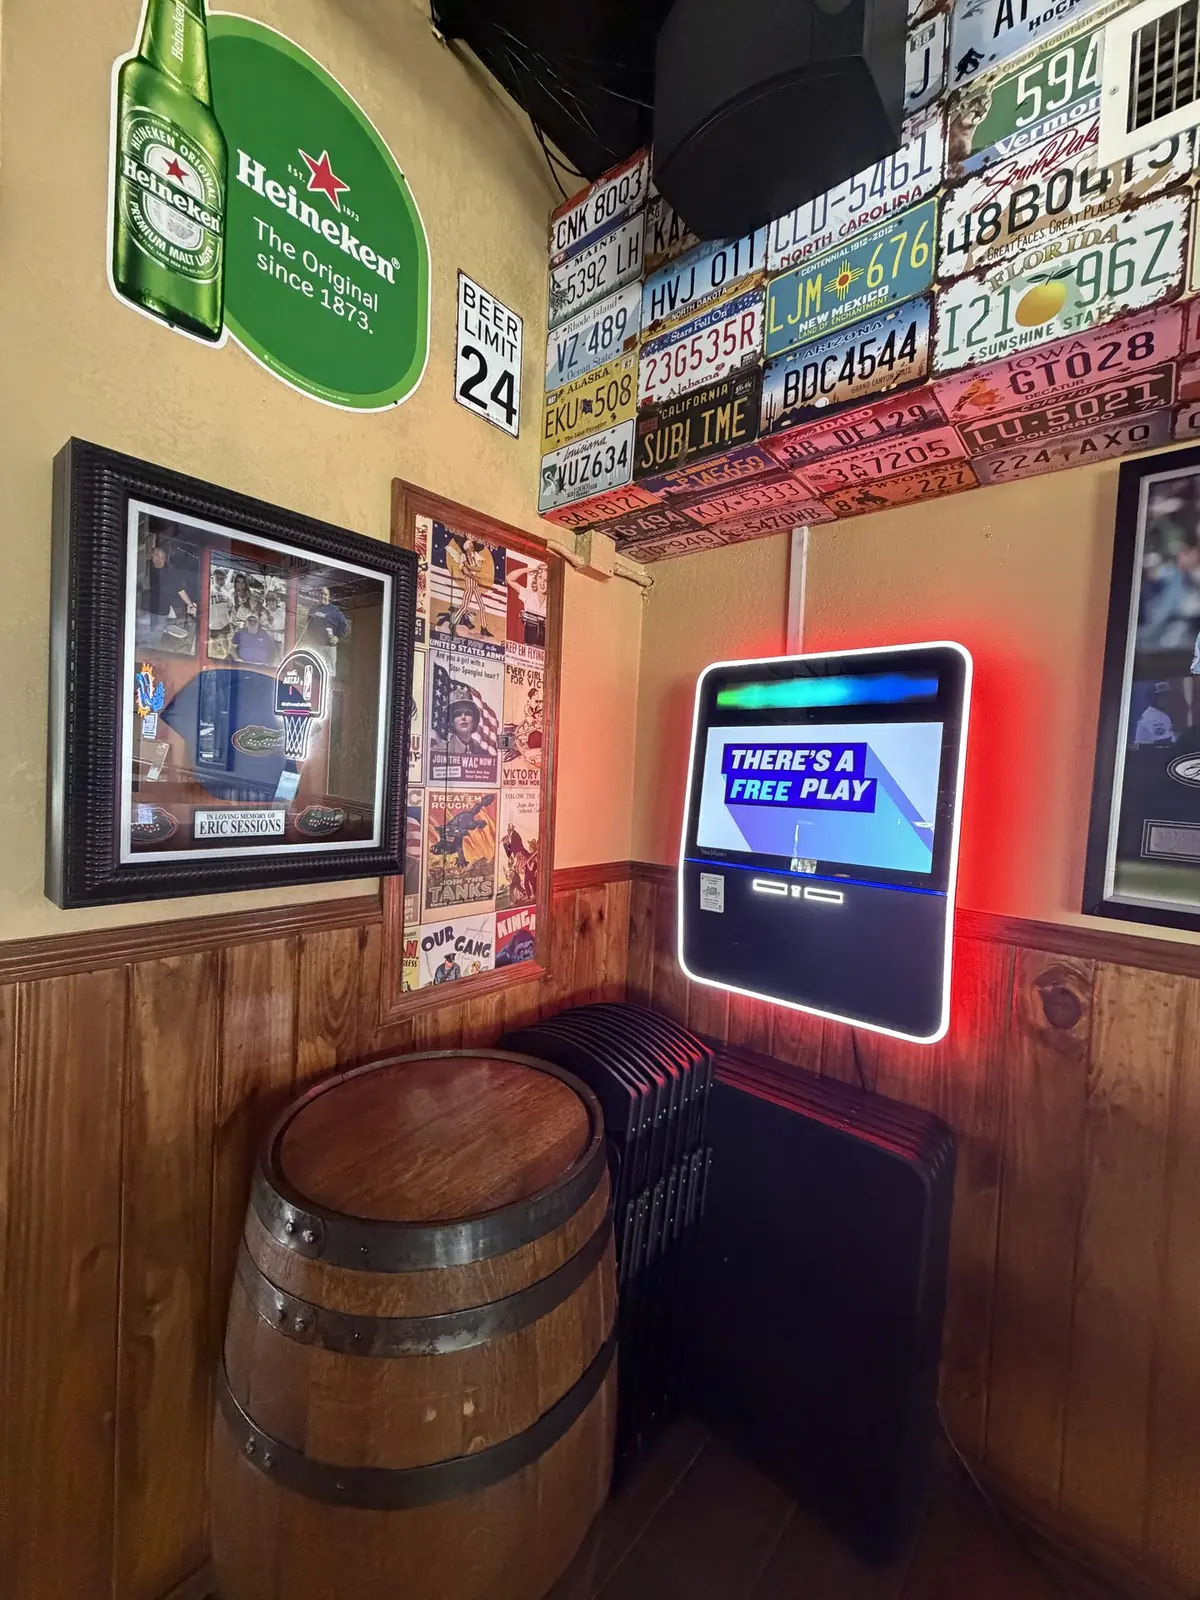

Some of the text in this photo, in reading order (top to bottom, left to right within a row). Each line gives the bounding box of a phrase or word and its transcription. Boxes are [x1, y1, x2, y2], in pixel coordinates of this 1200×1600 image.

[1002, 16, 1095, 73] Green Mountain
[131, 125, 176, 151] HEINEKEN
[179, 144, 217, 199] ORIGINAL
[287, 164, 306, 183] EST.
[123, 154, 221, 233] Heineken
[130, 201, 167, 253] PREMIUM
[169, 246, 195, 266] MALT
[194, 247, 215, 267] LAGER
[556, 203, 588, 250] CNK
[780, 184, 923, 268] NORTH CAROLINA
[986, 239, 1016, 261] GREAT
[1048, 215, 1080, 235] GREAT
[253, 216, 296, 259] The
[302, 250, 378, 312] Original
[574, 233, 617, 267] MAINE
[800, 247, 850, 278] CENTENNIAL
[986, 223, 1121, 292] FLORIDA
[567, 254, 607, 304] 5392
[617, 232, 639, 275] LH
[769, 219, 929, 334] LJM 676
[257, 253, 314, 298] since
[320, 288, 373, 334] 1873.
[651, 266, 695, 320] HVJ
[672, 303, 696, 321] NORTH
[696, 287, 727, 308] DAKOTA
[463, 282, 518, 342] BEER
[567, 297, 617, 335] Rhode Island
[799, 284, 889, 334] NEW MEXICO
[831, 295, 889, 325] ENCHANTMENT
[464, 309, 518, 363] LIMIT
[671, 327, 693, 343] Stars
[694, 318, 711, 332] Fell
[802, 321, 884, 361] ARIZONA
[978, 301, 1116, 359] SUNSHINE STATE
[566, 350, 613, 381] Ocean State
[644, 311, 755, 392] 23G535R
[783, 321, 917, 410] BDC4544
[1005, 340, 1088, 373] IOWA
[459, 344, 517, 426] 24
[567, 367, 610, 394] ALASKA
[666, 371, 720, 399] Alabama
[851, 380, 871, 394] GRAND
[871, 373, 894, 389] CANYON
[959, 371, 994, 385] Natural
[1025, 378, 1086, 401] DECATUR
[544, 398, 579, 440] EKU
[594, 374, 632, 417] 508
[661, 383, 729, 420] CALIFORNIA
[1020, 385, 1098, 413] Colorful
[641, 397, 749, 469] SUBLIME
[815, 408, 873, 434] IDAHO
[1014, 412, 1116, 443] COLORADO
[558, 440, 628, 487] VUZ634
[563, 436, 608, 463] Louisiana
[827, 440, 909, 466] MARYLAND
[862, 439, 951, 474] 7205
[989, 449, 1052, 475] 224
[875, 459, 970, 491] WYOMING
[918, 470, 965, 494] 227
[692, 500, 737, 519] KJX
[740, 482, 800, 506] 5333
[429, 639, 505, 661] UNITED STATES ARMY
[461, 655, 470, 664] girl
[527, 647, 545, 661] FLYING
[484, 672, 500, 680] heart?
[506, 665, 541, 680] EVERY GIRL
[510, 676, 524, 686] FOR
[432, 754, 447, 764] JOIN
[448, 755, 461, 764] THE
[461, 756, 479, 768] WAC
[503, 769, 539, 779] VICTORY
[731, 749, 854, 772] THERE'S A
[431, 794, 466, 802] TREAT
[730, 778, 872, 802] FREE PLAY
[199, 818, 281, 835] ERIC SESSIONS
[240, 812, 266, 820] MEMORY
[428, 881, 493, 903] TANKS
[421, 925, 455, 952] OUR
[497, 910, 530, 939] KING
[454, 936, 493, 958] GANG
